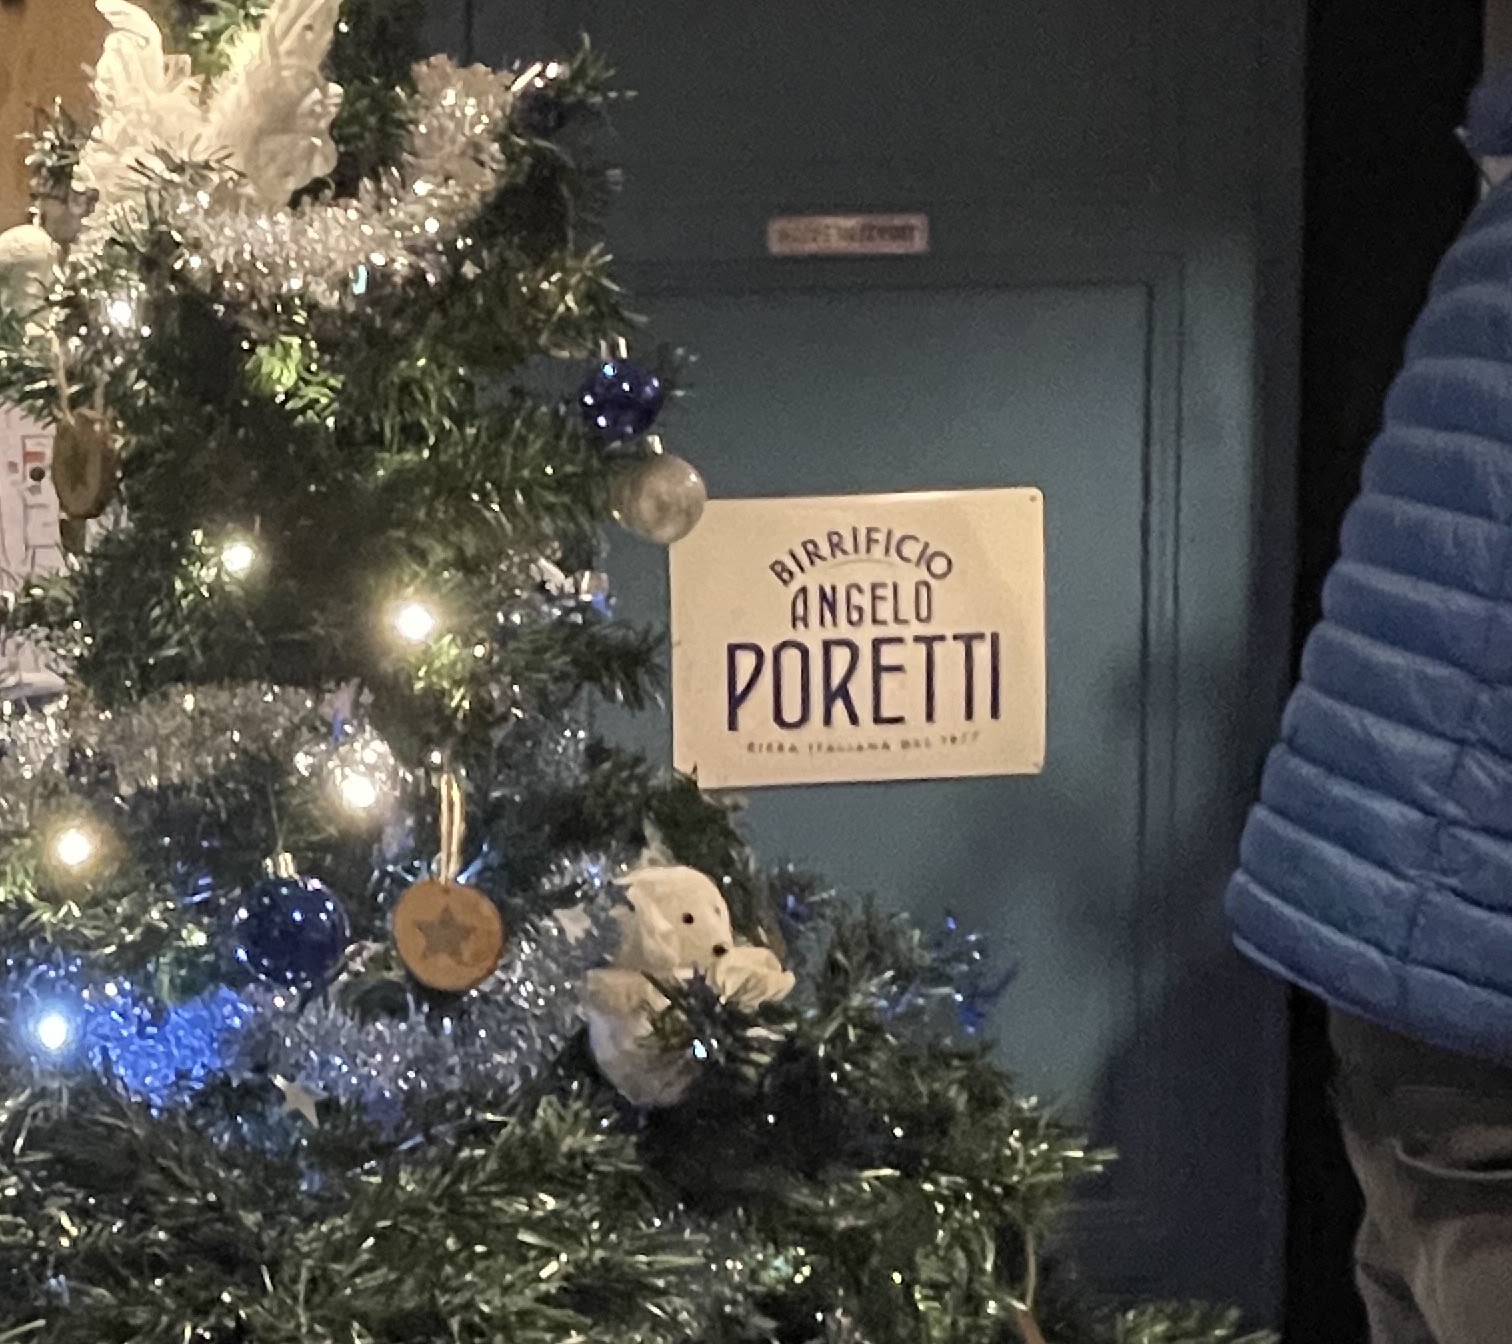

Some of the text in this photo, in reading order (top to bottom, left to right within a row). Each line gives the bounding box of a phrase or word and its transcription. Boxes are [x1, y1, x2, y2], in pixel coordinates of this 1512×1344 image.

[769, 525, 953, 587] BIRRIFICIO
[791, 580, 932, 630] ANGELO
[726, 632, 1000, 732] PORETTI
